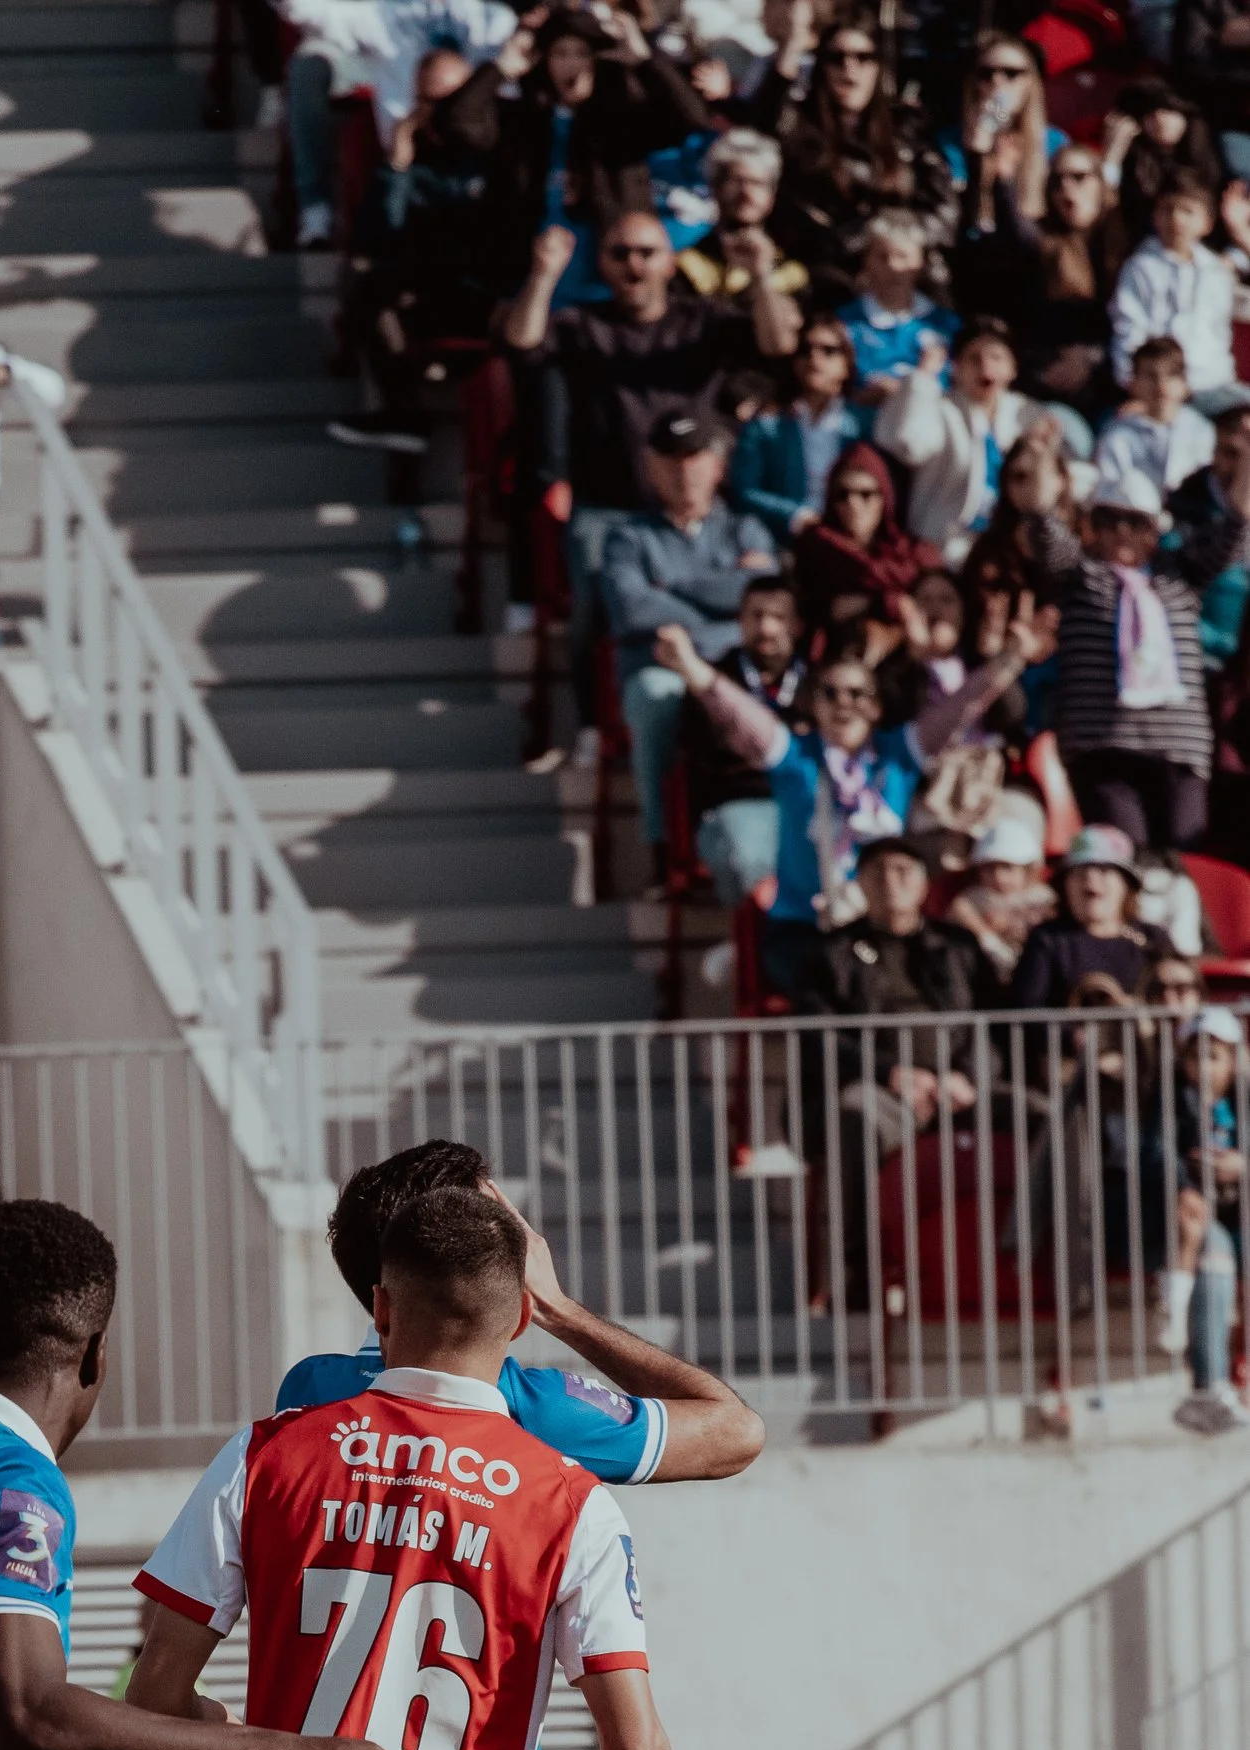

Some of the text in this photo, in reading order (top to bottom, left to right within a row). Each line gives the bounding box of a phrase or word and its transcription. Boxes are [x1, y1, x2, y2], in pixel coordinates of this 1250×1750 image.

[339, 1430, 520, 1496] amco
[351, 1469, 495, 1510] intermediários crédito
[6, 1511, 49, 1563] 3
[322, 1494, 493, 1571] TOMÁS M.
